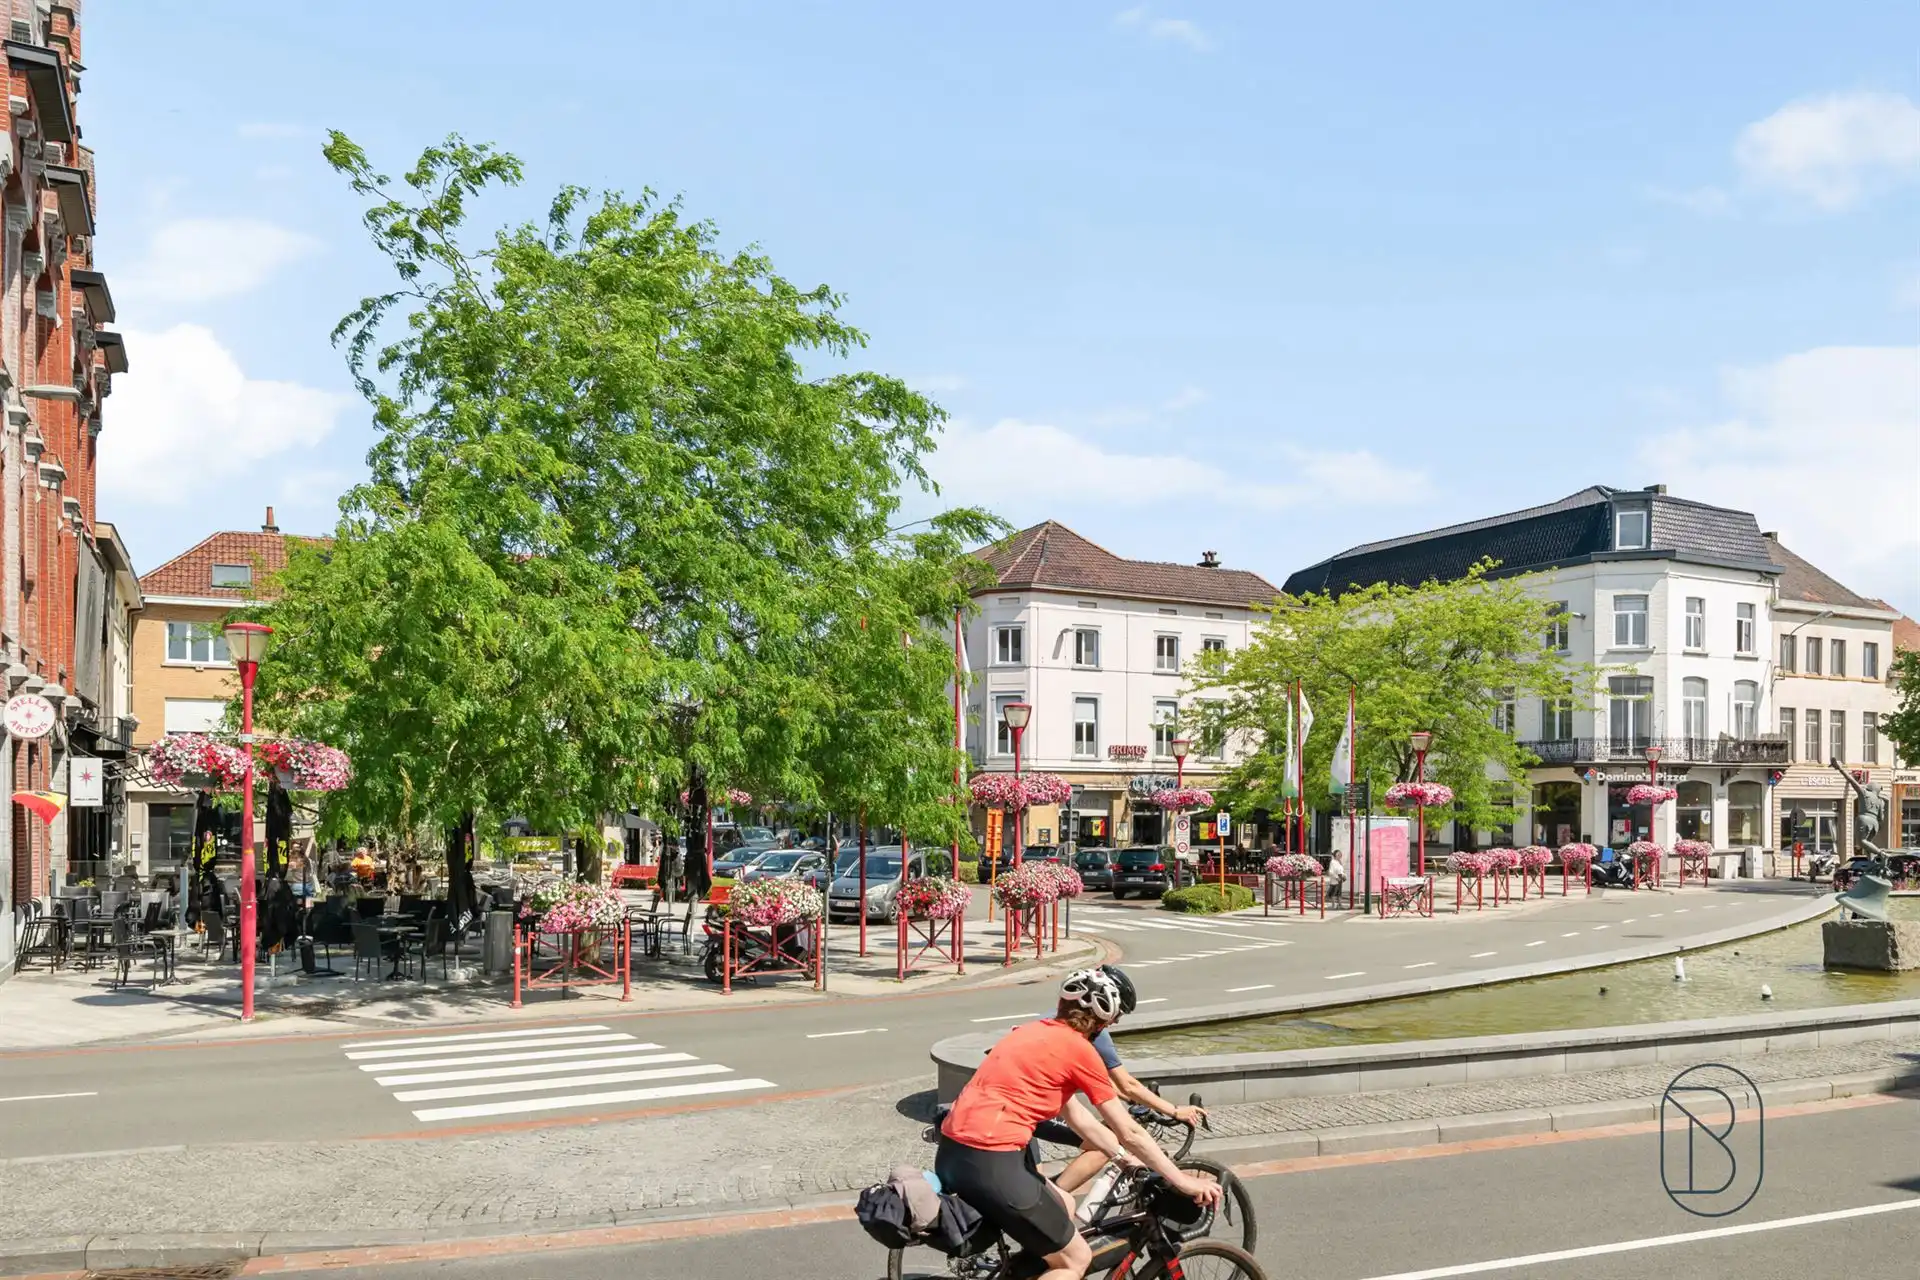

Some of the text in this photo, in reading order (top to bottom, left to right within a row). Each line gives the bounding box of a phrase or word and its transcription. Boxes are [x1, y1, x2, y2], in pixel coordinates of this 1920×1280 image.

[10, 697, 49, 712] STELLA
[10, 719, 49, 734] ARTOIS
[1109, 745, 1149, 756] PRIMUS
[1597, 772, 1687, 782] Domino's Pizza
